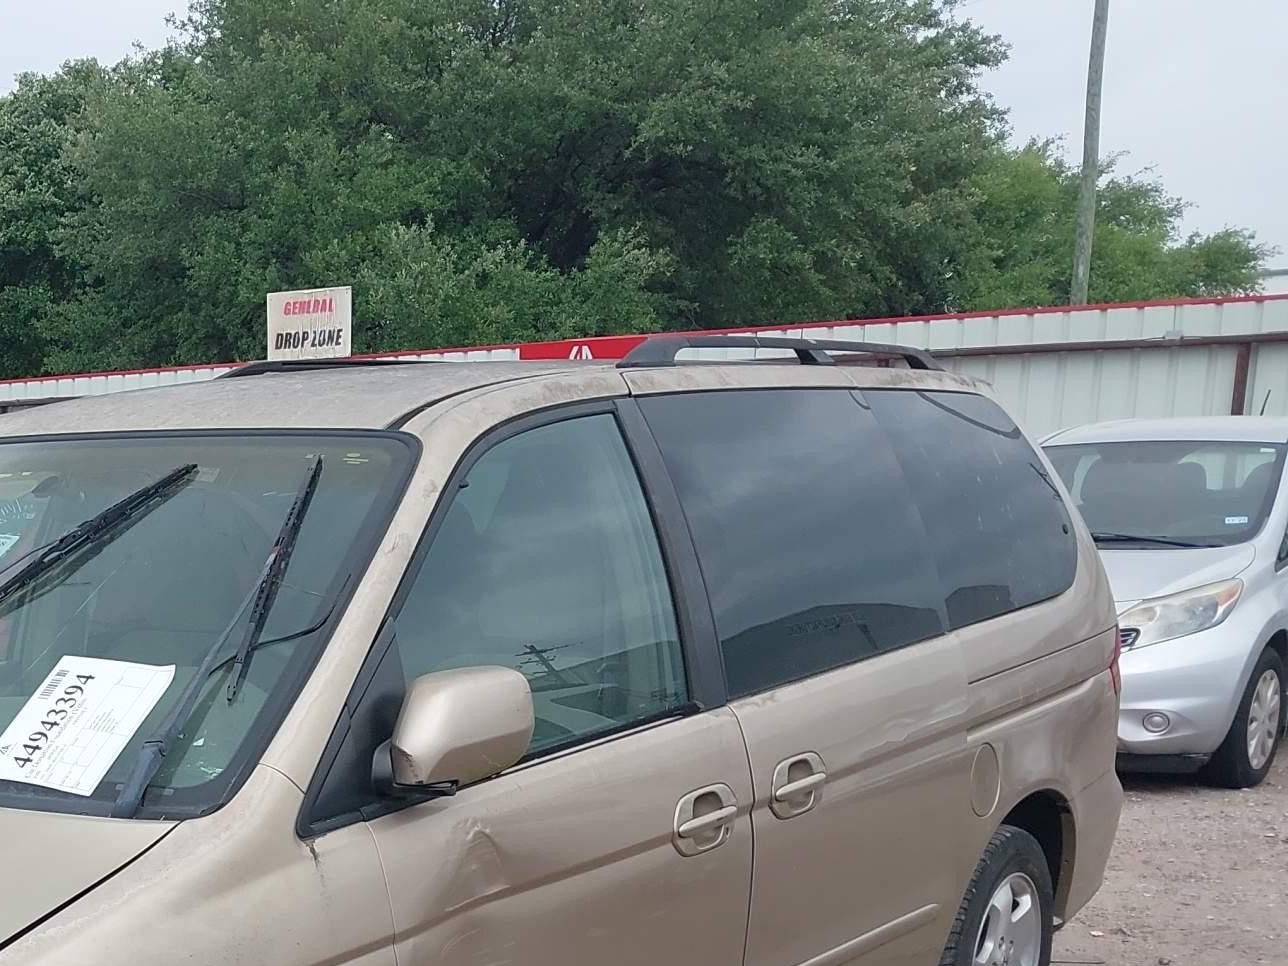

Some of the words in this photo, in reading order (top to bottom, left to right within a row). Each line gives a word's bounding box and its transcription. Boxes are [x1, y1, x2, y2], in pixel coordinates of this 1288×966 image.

[283, 298, 334, 316] GENERAL
[275, 331, 309, 350] DROP
[310, 328, 343, 348] ZONE
[13, 673, 96, 769] 44943394
